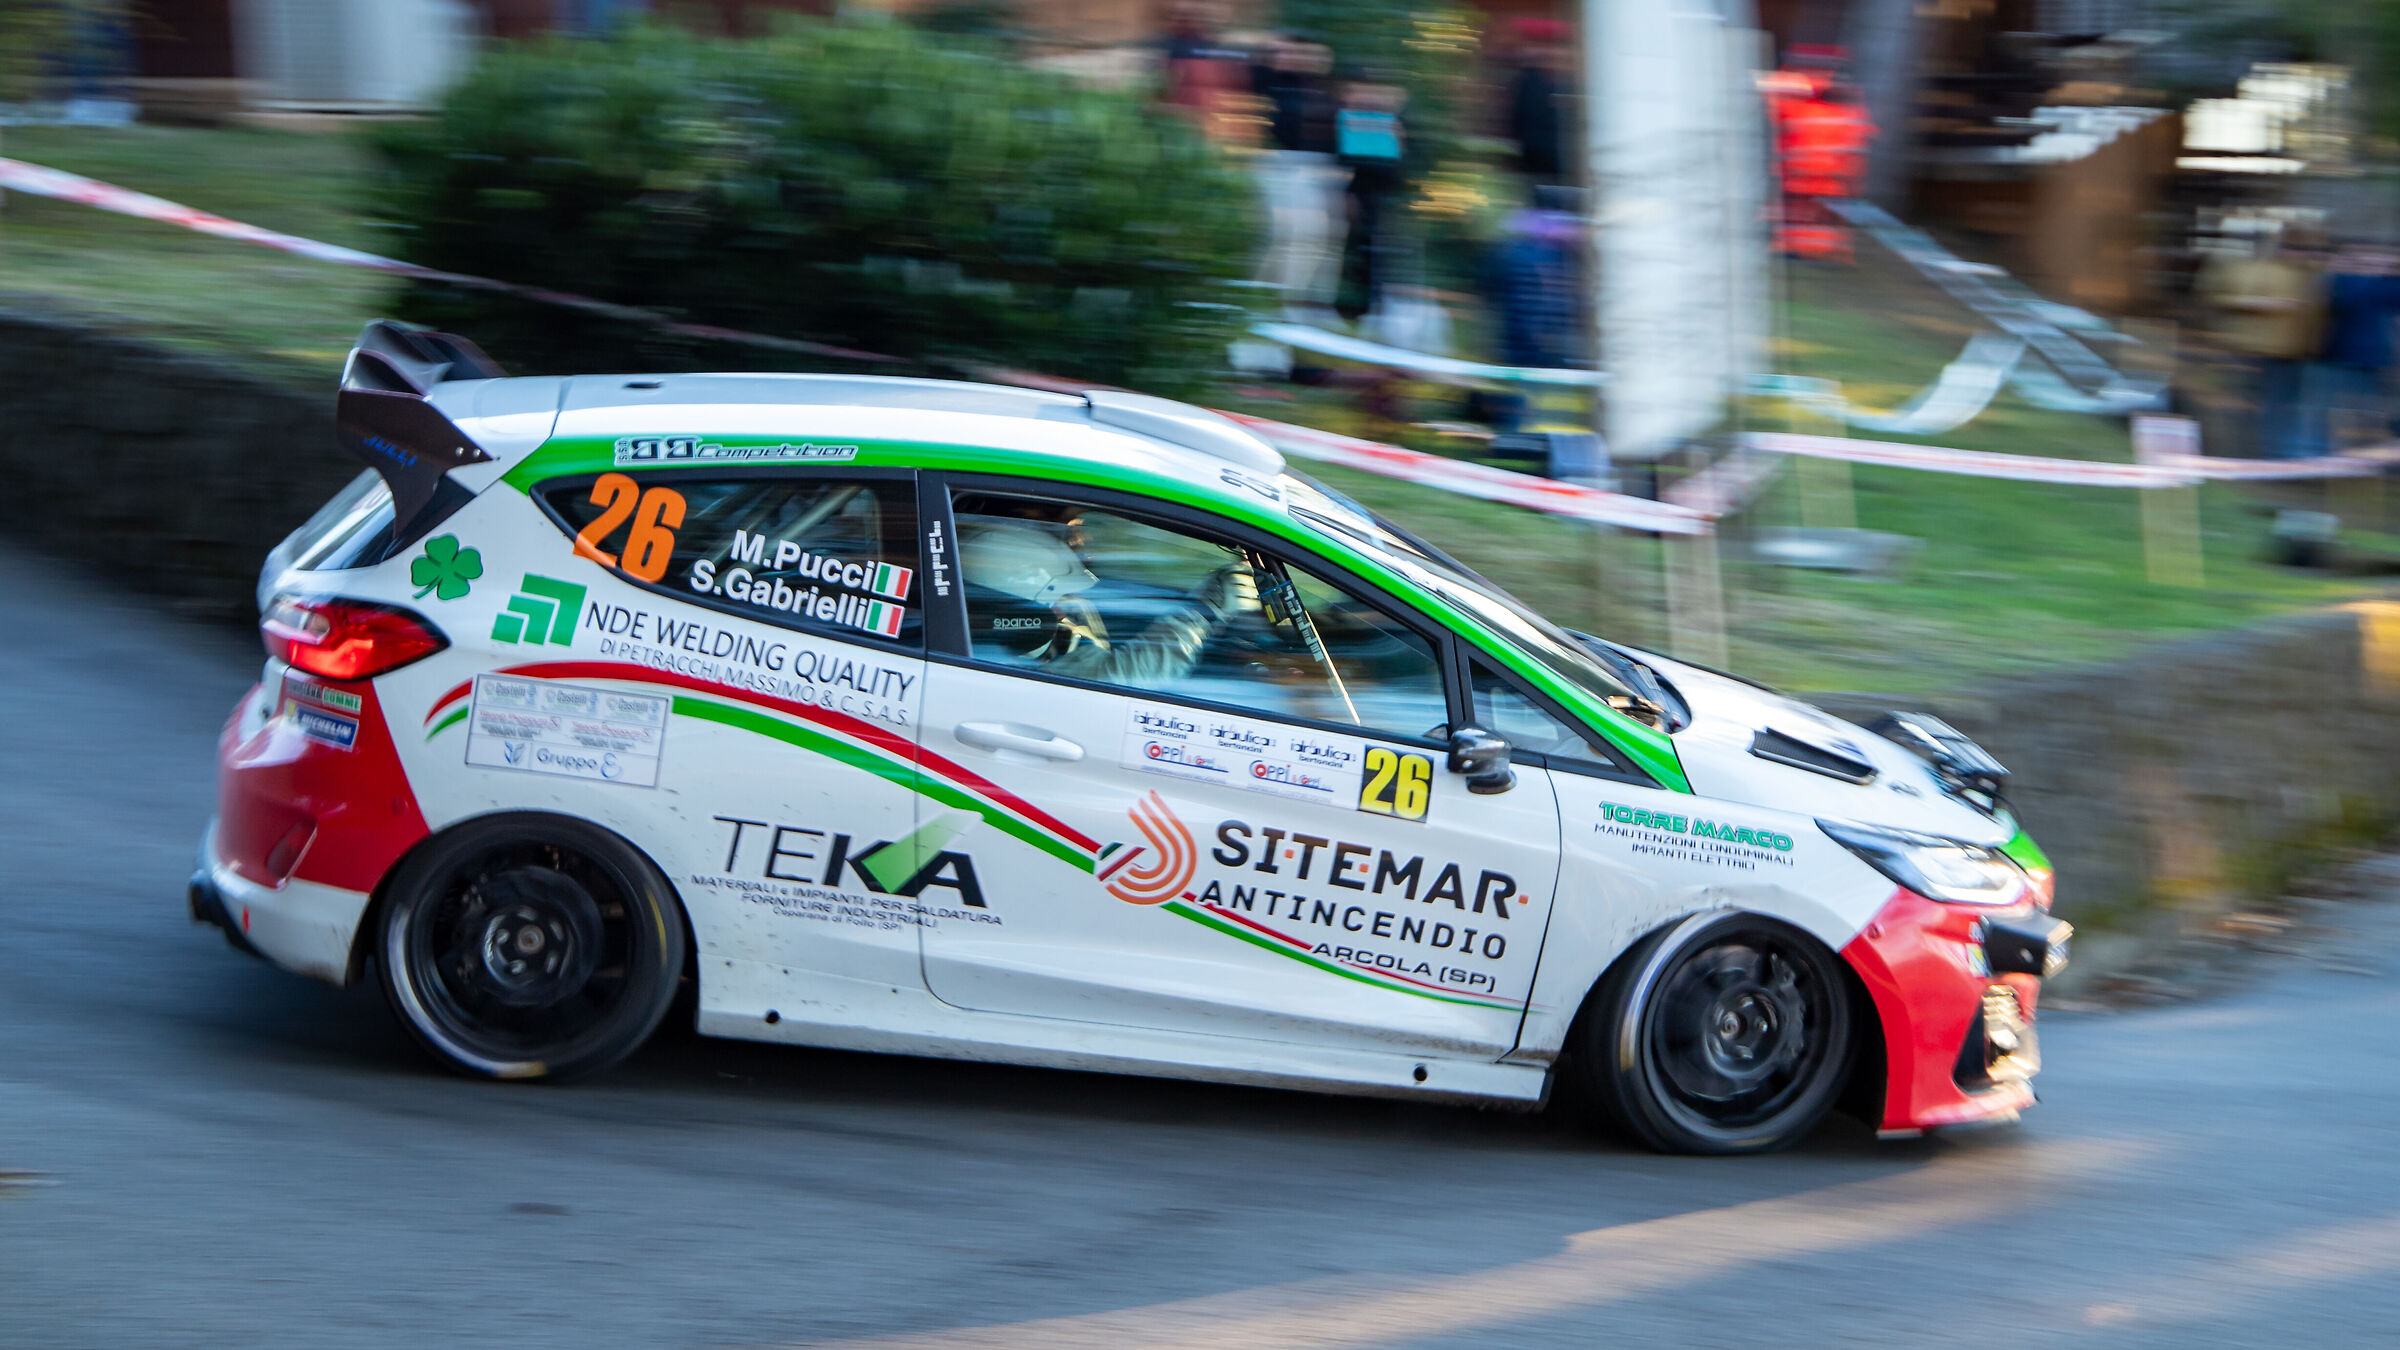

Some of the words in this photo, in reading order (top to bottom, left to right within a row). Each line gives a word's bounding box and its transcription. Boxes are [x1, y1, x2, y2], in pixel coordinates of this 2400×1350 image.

[698, 443, 856, 459] Competition
[573, 473, 687, 584] 26
[730, 528, 875, 591] M.Pucci
[690, 559, 867, 630] S.Gabrielli
[585, 601, 649, 640] NDE
[657, 615, 788, 672] WELDING
[794, 650, 915, 702] QUALITY
[600, 638, 616, 655] DI
[619, 642, 720, 682] PETRACCHI
[725, 666, 815, 702] MASSIMO
[820, 689, 835, 709] &
[536, 747, 598, 772] Gruppo
[1360, 747, 1432, 820] 26
[1594, 823, 1697, 848] MANUTENZIONI
[1701, 840, 1794, 866] CONDOMINIALI
[1599, 801, 1689, 834] TORRE
[1691, 816, 1794, 852] MARCO
[1632, 843, 1687, 860] IMPIANTI
[712, 815, 988, 909] TEKA
[691, 874, 778, 894] MATERIALI
[793, 887, 865, 905] IMPIANTI
[871, 897, 904, 911] PER
[907, 902, 1003, 926] SALDATURA
[742, 892, 834, 913] FORNITURE
[837, 904, 939, 928] INDUSTRIALI
[1199, 880, 1507, 960] ANTINCENDIO
[1311, 943, 1433, 977] ARCOLA
[1439, 966, 1497, 993] (SP)
